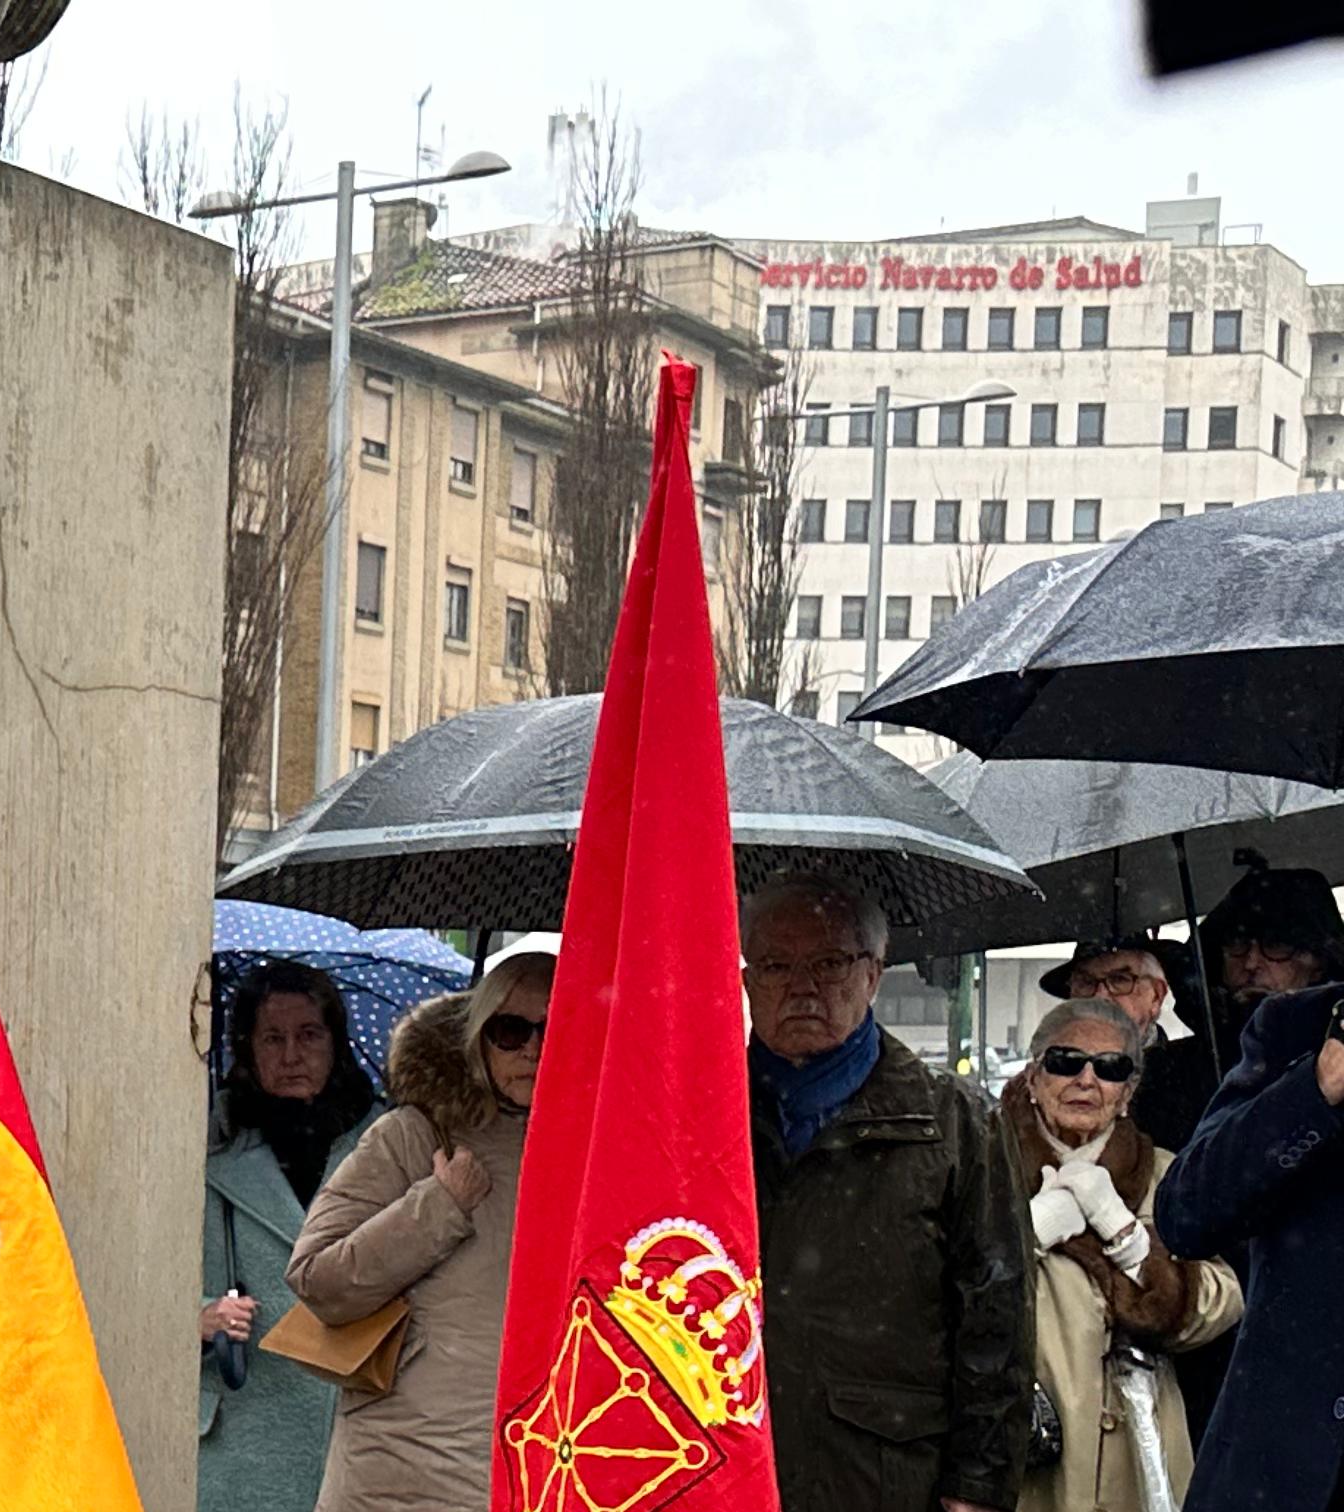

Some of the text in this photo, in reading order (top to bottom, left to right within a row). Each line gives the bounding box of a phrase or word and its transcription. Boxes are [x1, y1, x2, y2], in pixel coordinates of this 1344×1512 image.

[880, 256, 998, 291] Navarro
[1010, 257, 1044, 290] de
[1055, 255, 1143, 290] Salud
